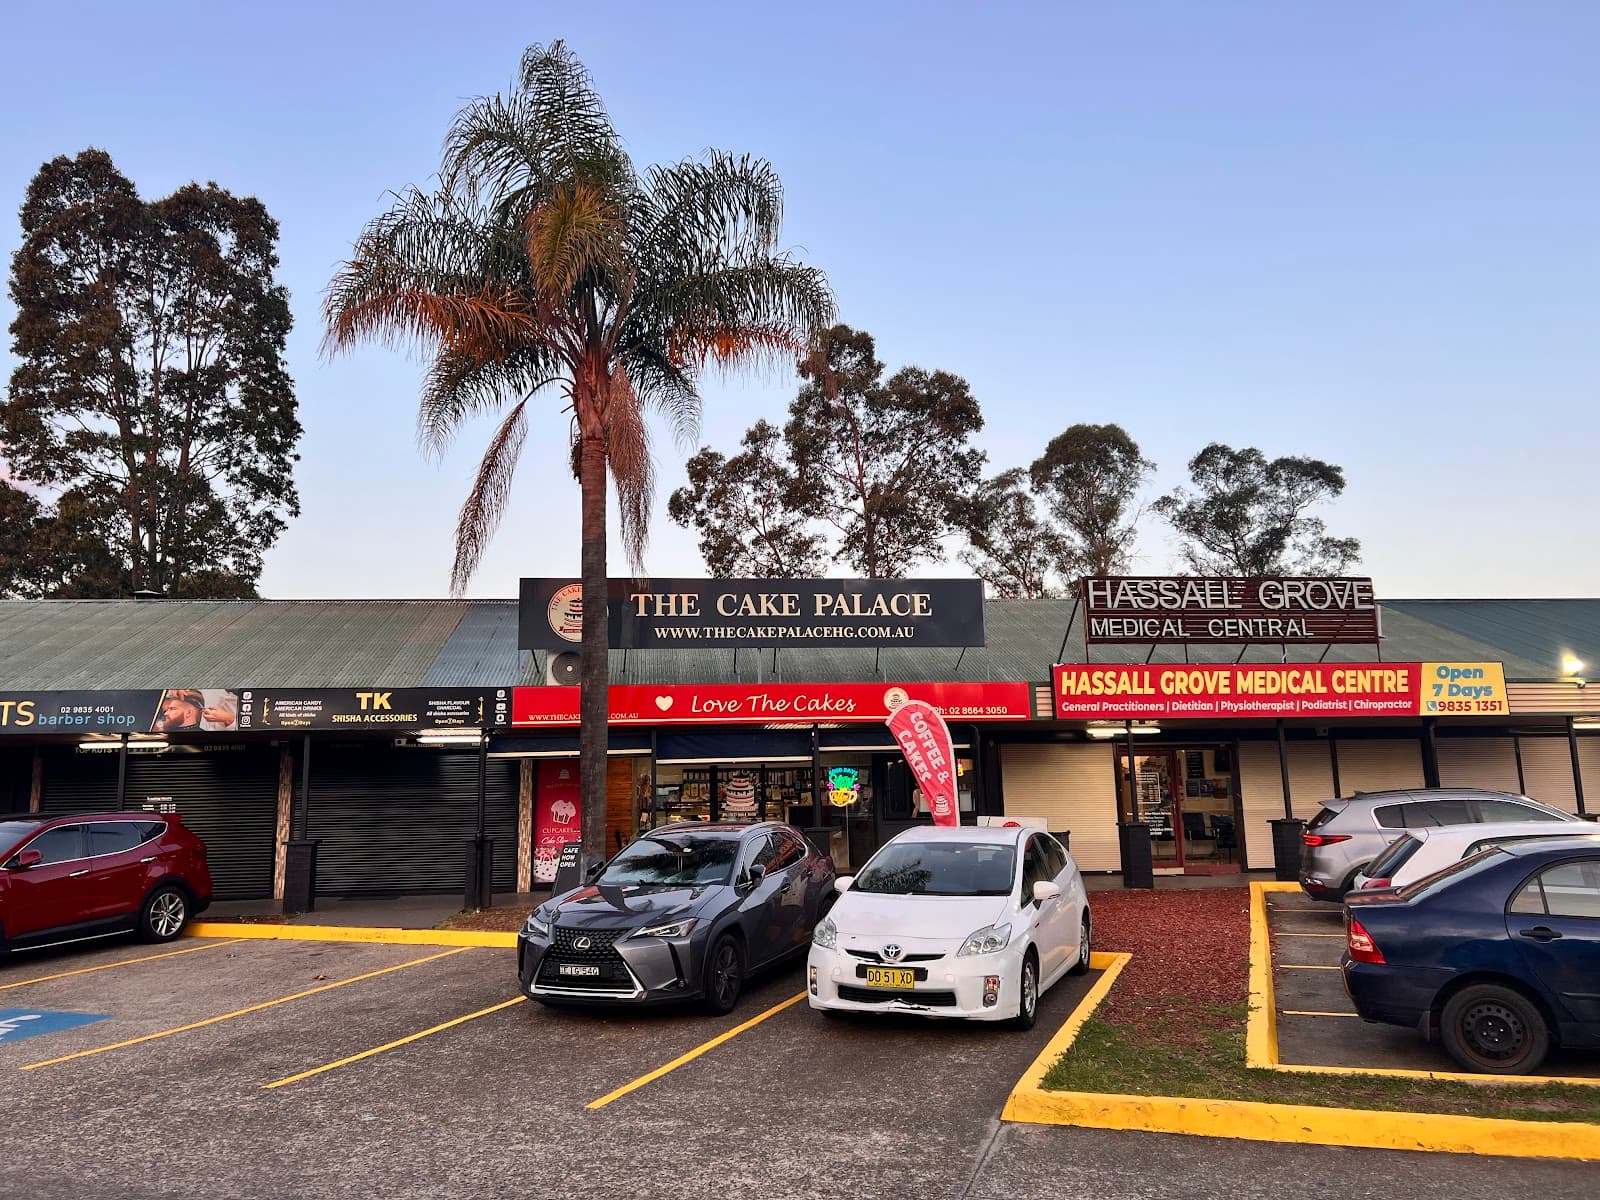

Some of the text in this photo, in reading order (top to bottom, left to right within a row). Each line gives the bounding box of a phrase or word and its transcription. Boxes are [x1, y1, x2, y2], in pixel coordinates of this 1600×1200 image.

[1087, 579, 1375, 610] HASSALL GROVE
[630, 592, 933, 617] THE CAKE PALACE
[653, 625, 915, 639] WWW.THECAKEPALACEHG.COM.AU
[1091, 618, 1314, 637] MEDICAL CENTRAL
[1436, 665, 1484, 682] Open
[1061, 669, 1409, 696] HASSALL GROVE MEDICAL CENTRE
[1432, 683, 1493, 700] 7 Days
[355, 692, 393, 710] TK
[691, 692, 857, 713] Love The Cakes
[1061, 698, 1412, 713] General Practitioners Dietitian Physiotherapist Podiatrist Chiropractor
[1438, 700, 1503, 712] 9835 1351
[60, 706, 114, 714] 02 9835 4001
[331, 713, 418, 723] SHISHA ACCESSORIES
[949, 706, 960, 715] 02
[962, 706, 984, 715] 8664
[985, 706, 1008, 715] 3050
[38, 713, 136, 727] barber shop
[910, 711, 949, 784] COFFEE &
[898, 730, 933, 783] CAKES
[884, 971, 895, 984] 51
